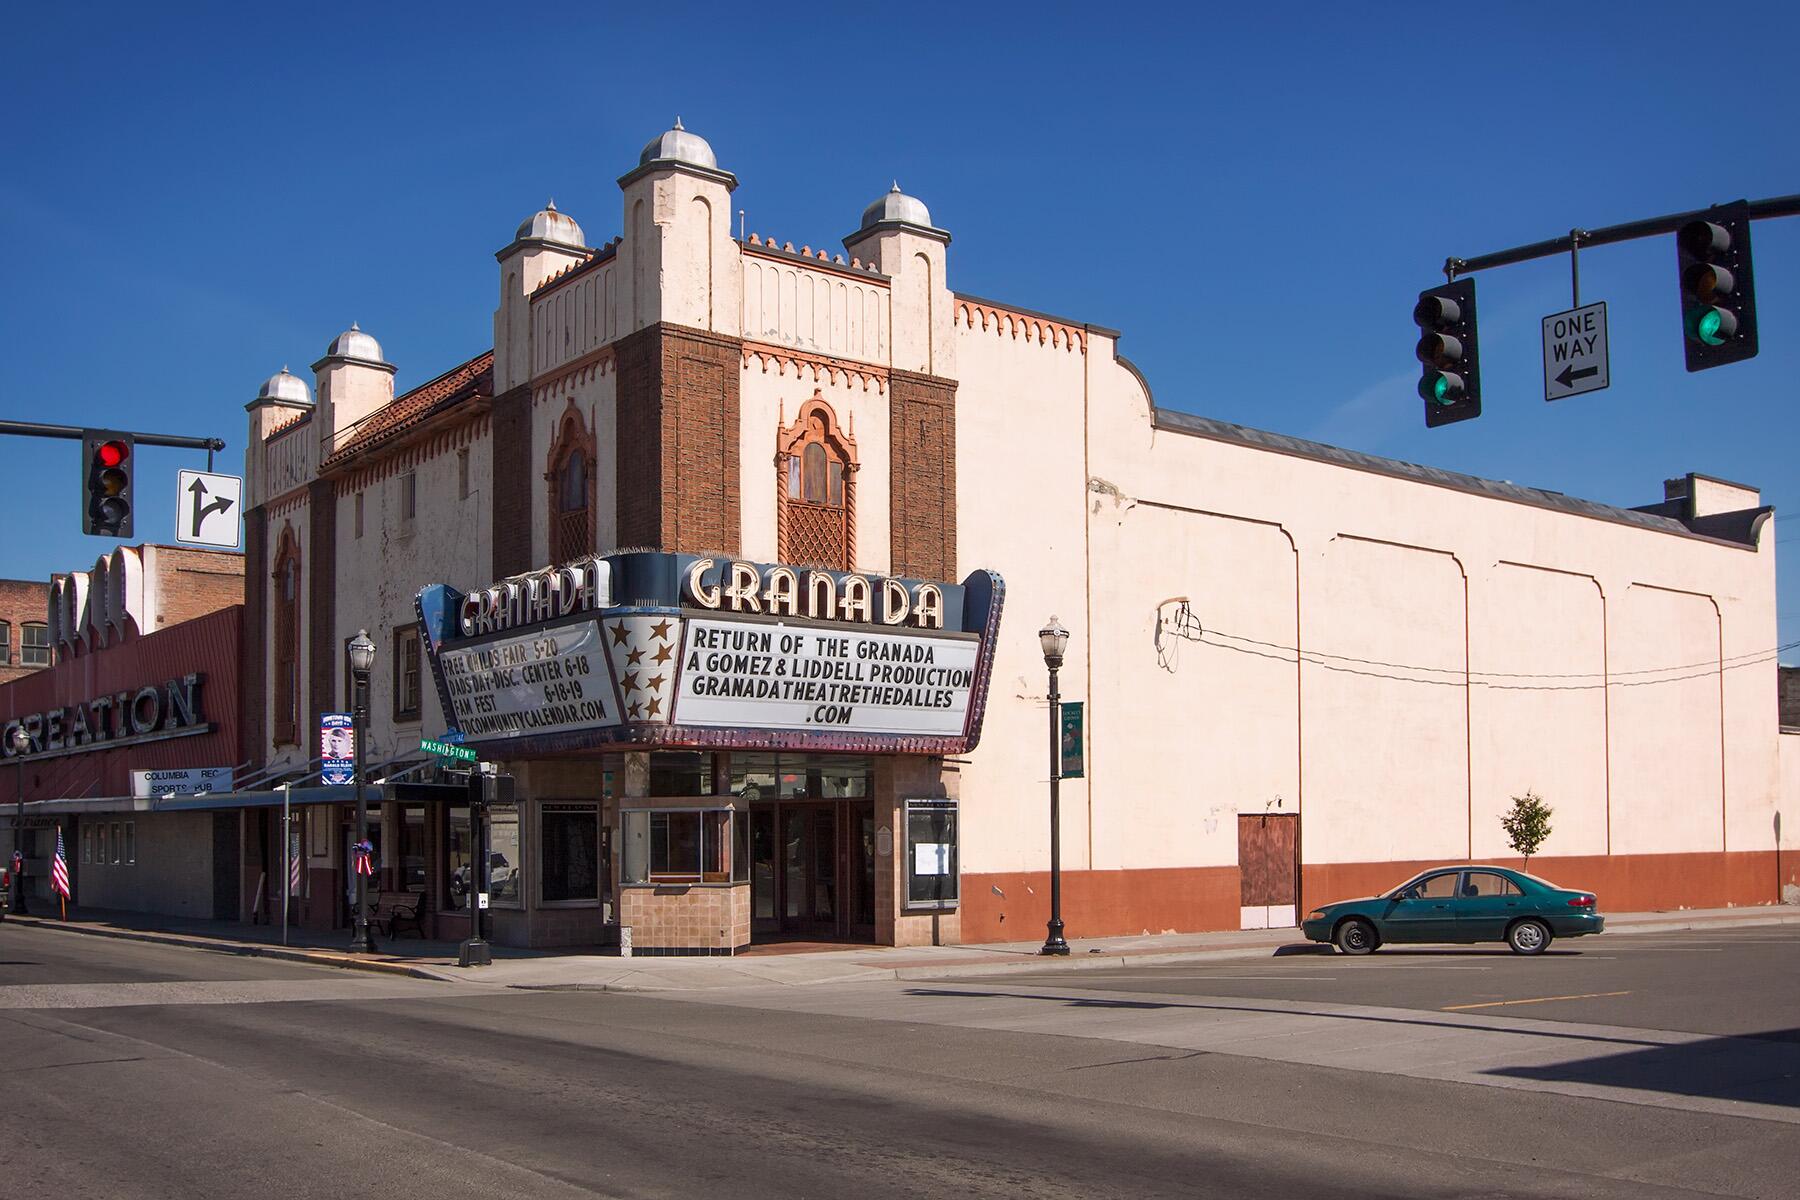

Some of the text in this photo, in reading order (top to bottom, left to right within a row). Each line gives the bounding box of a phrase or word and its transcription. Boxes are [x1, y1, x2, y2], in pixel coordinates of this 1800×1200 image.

[1554, 312, 1596, 339] ONE
[1553, 334, 1598, 362] WAY
[460, 558, 604, 637] GRANADA
[688, 557, 944, 630] GRANADA
[442, 656, 465, 676] FREE
[503, 644, 527, 665] FAIR
[533, 638, 558, 660] 5-20
[693, 627, 934, 665] RETURN OF THE GRANADA
[522, 662, 563, 685] CENTER
[565, 655, 590, 677] 6-18
[687, 651, 973, 689] A GOMEZ & LIDDELL PRODUCTION
[454, 680, 583, 716] FAM FEST 6-18-19
[692, 675, 953, 708] GRANADATHEATRETHEDALLES
[806, 705, 853, 724] .COM
[421, 740, 470, 759] WASHINGTON
[144, 769, 219, 781] COLUMBIA REC
[152, 783, 213, 793] SPORTS PUB
